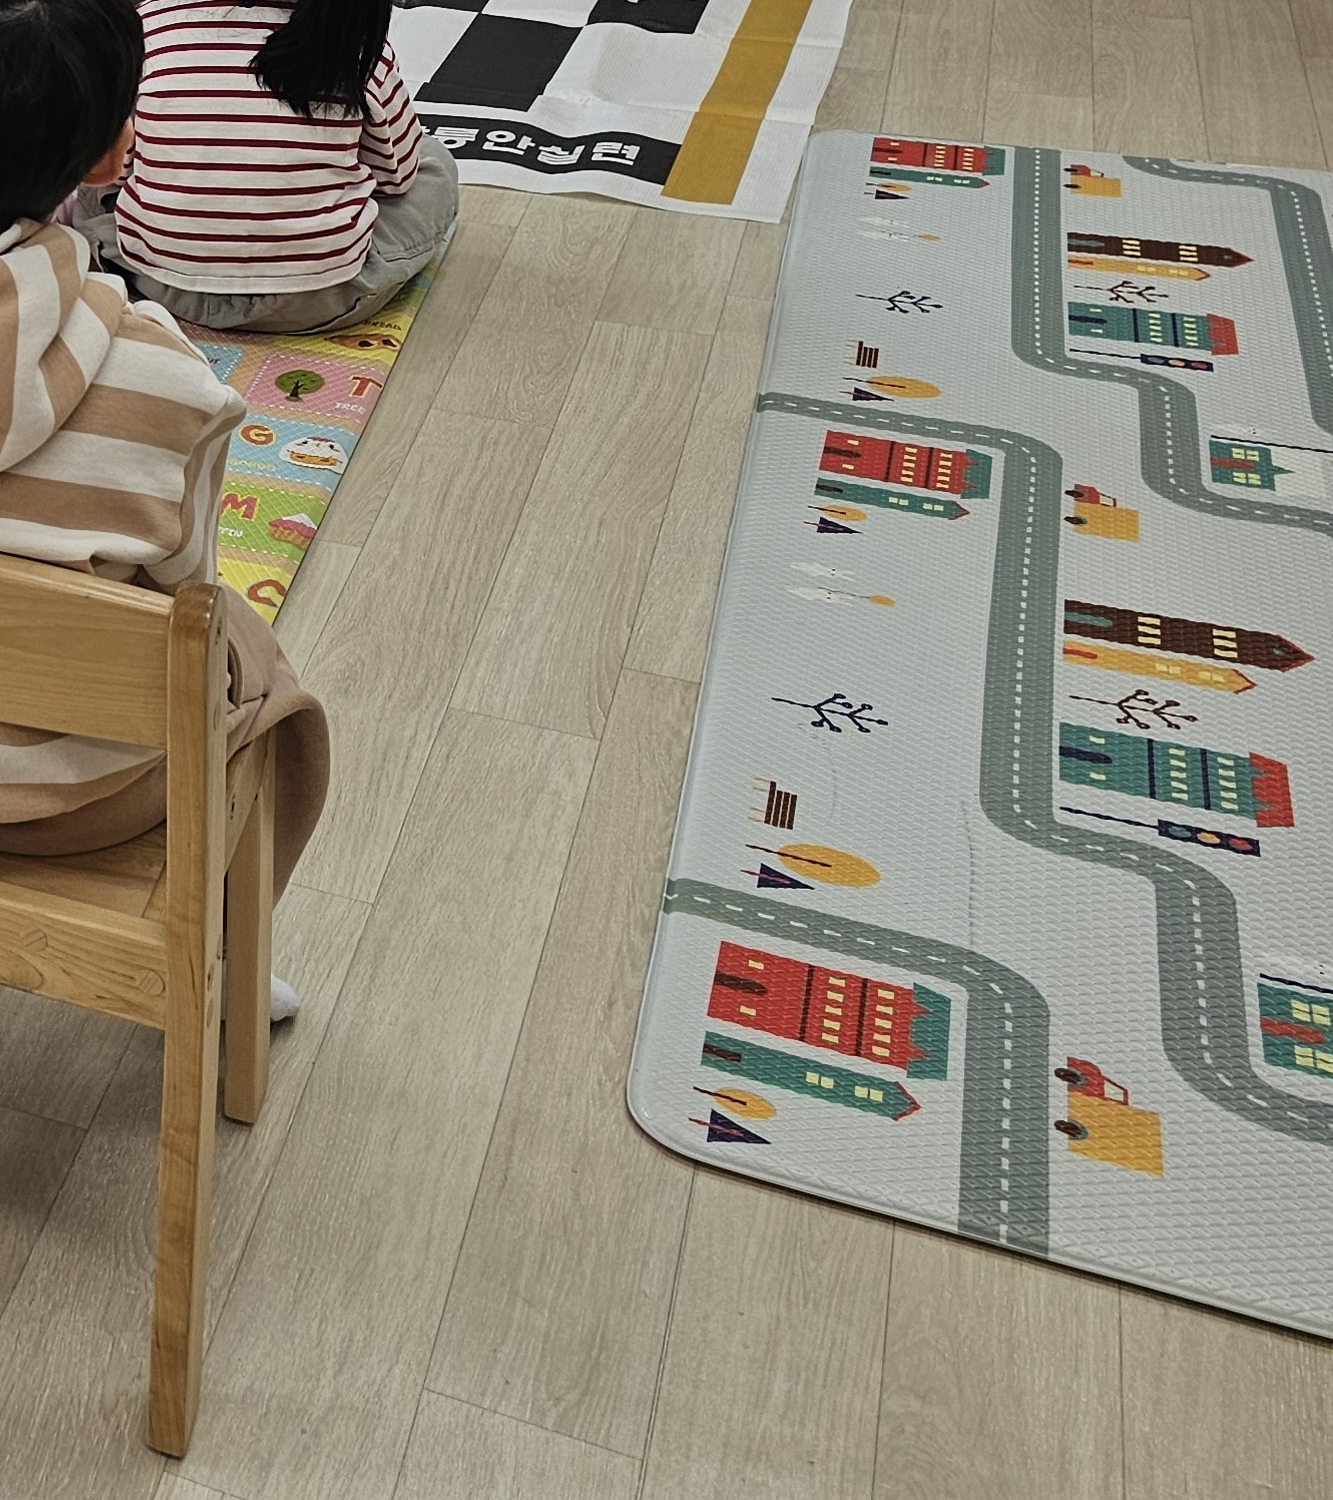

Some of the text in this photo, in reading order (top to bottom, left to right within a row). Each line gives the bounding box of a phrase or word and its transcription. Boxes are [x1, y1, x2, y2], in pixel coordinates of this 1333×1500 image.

[423, 125, 641, 167] 릉안실련
[347, 373, 383, 398] T
[237, 422, 276, 446] G
[220, 492, 260, 521] M
